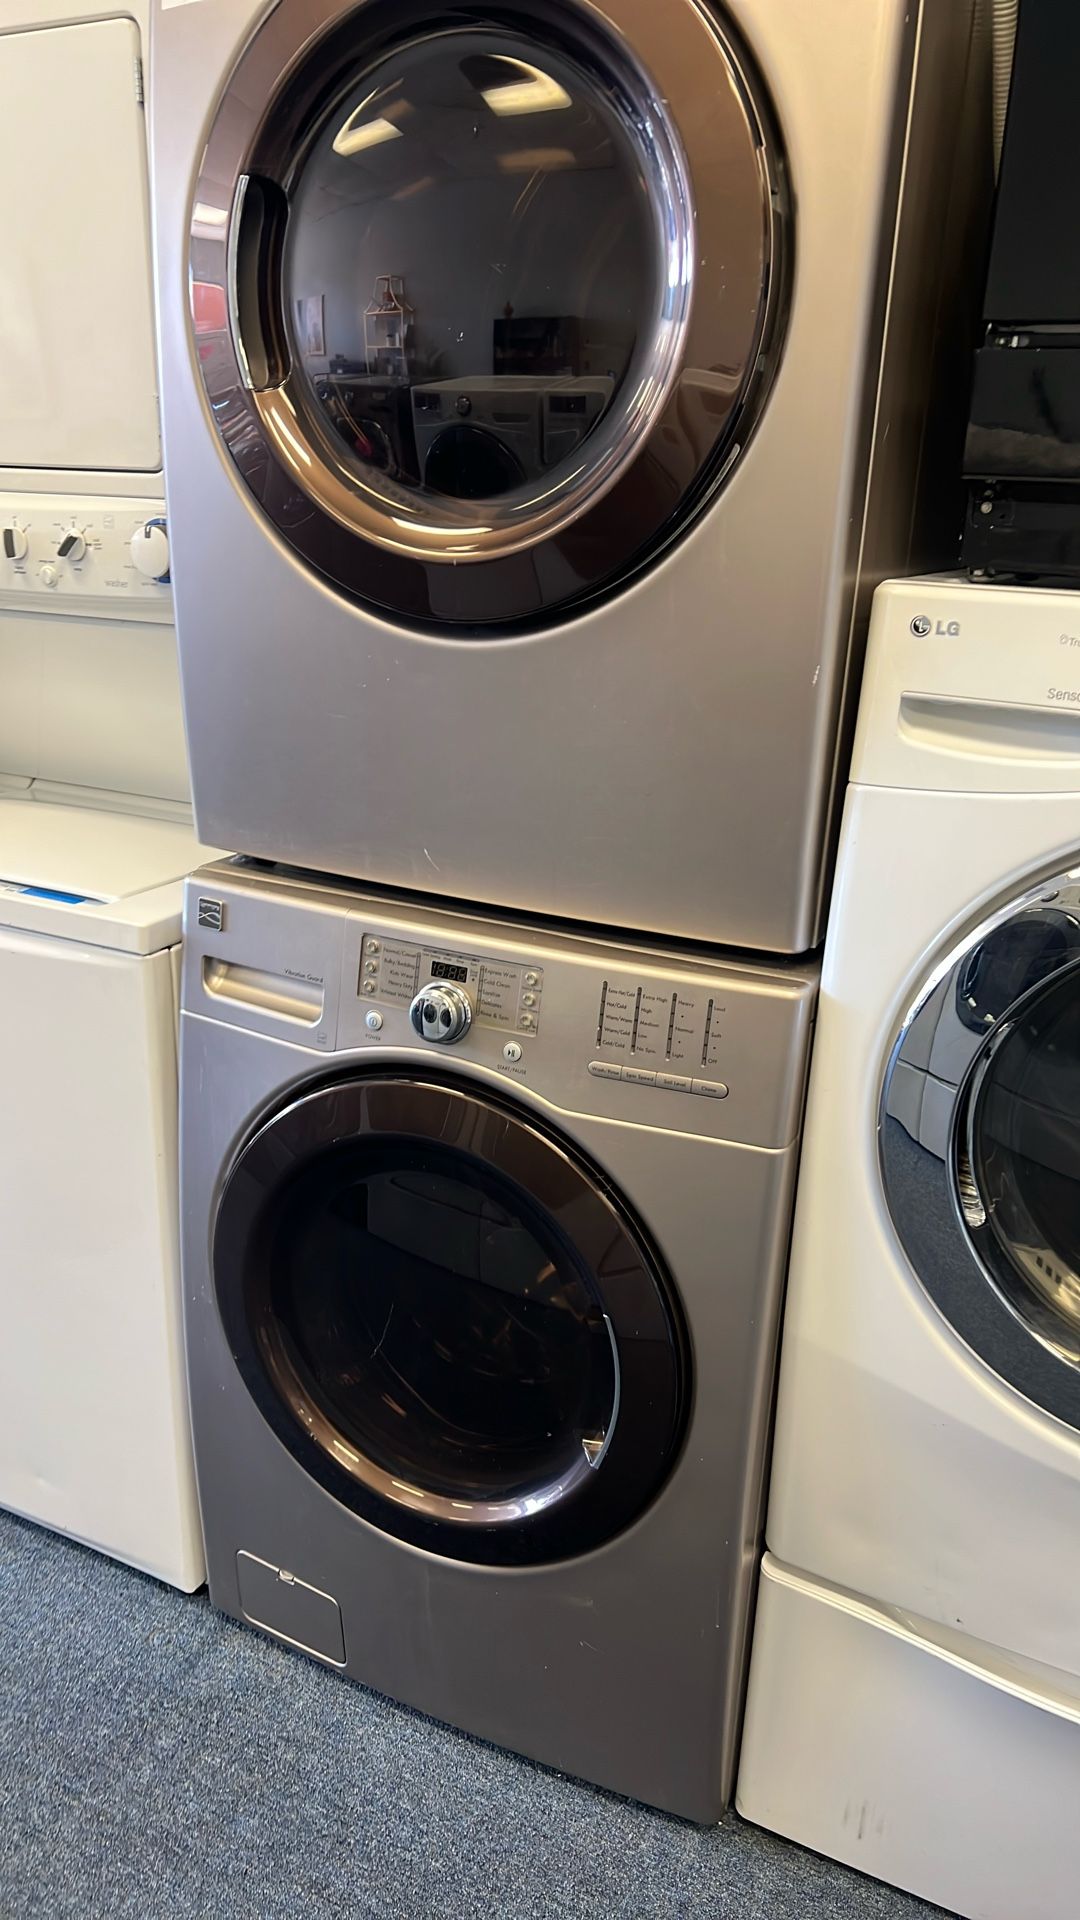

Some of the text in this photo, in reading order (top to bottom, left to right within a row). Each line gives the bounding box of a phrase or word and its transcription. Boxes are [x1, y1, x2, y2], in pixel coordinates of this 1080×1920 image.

[935, 620, 960, 636] LG
[678, 1000, 694, 1008] Heavy
[675, 1026, 694, 1034] Normal
[602, 1040, 625, 1048] Cold/Cold
